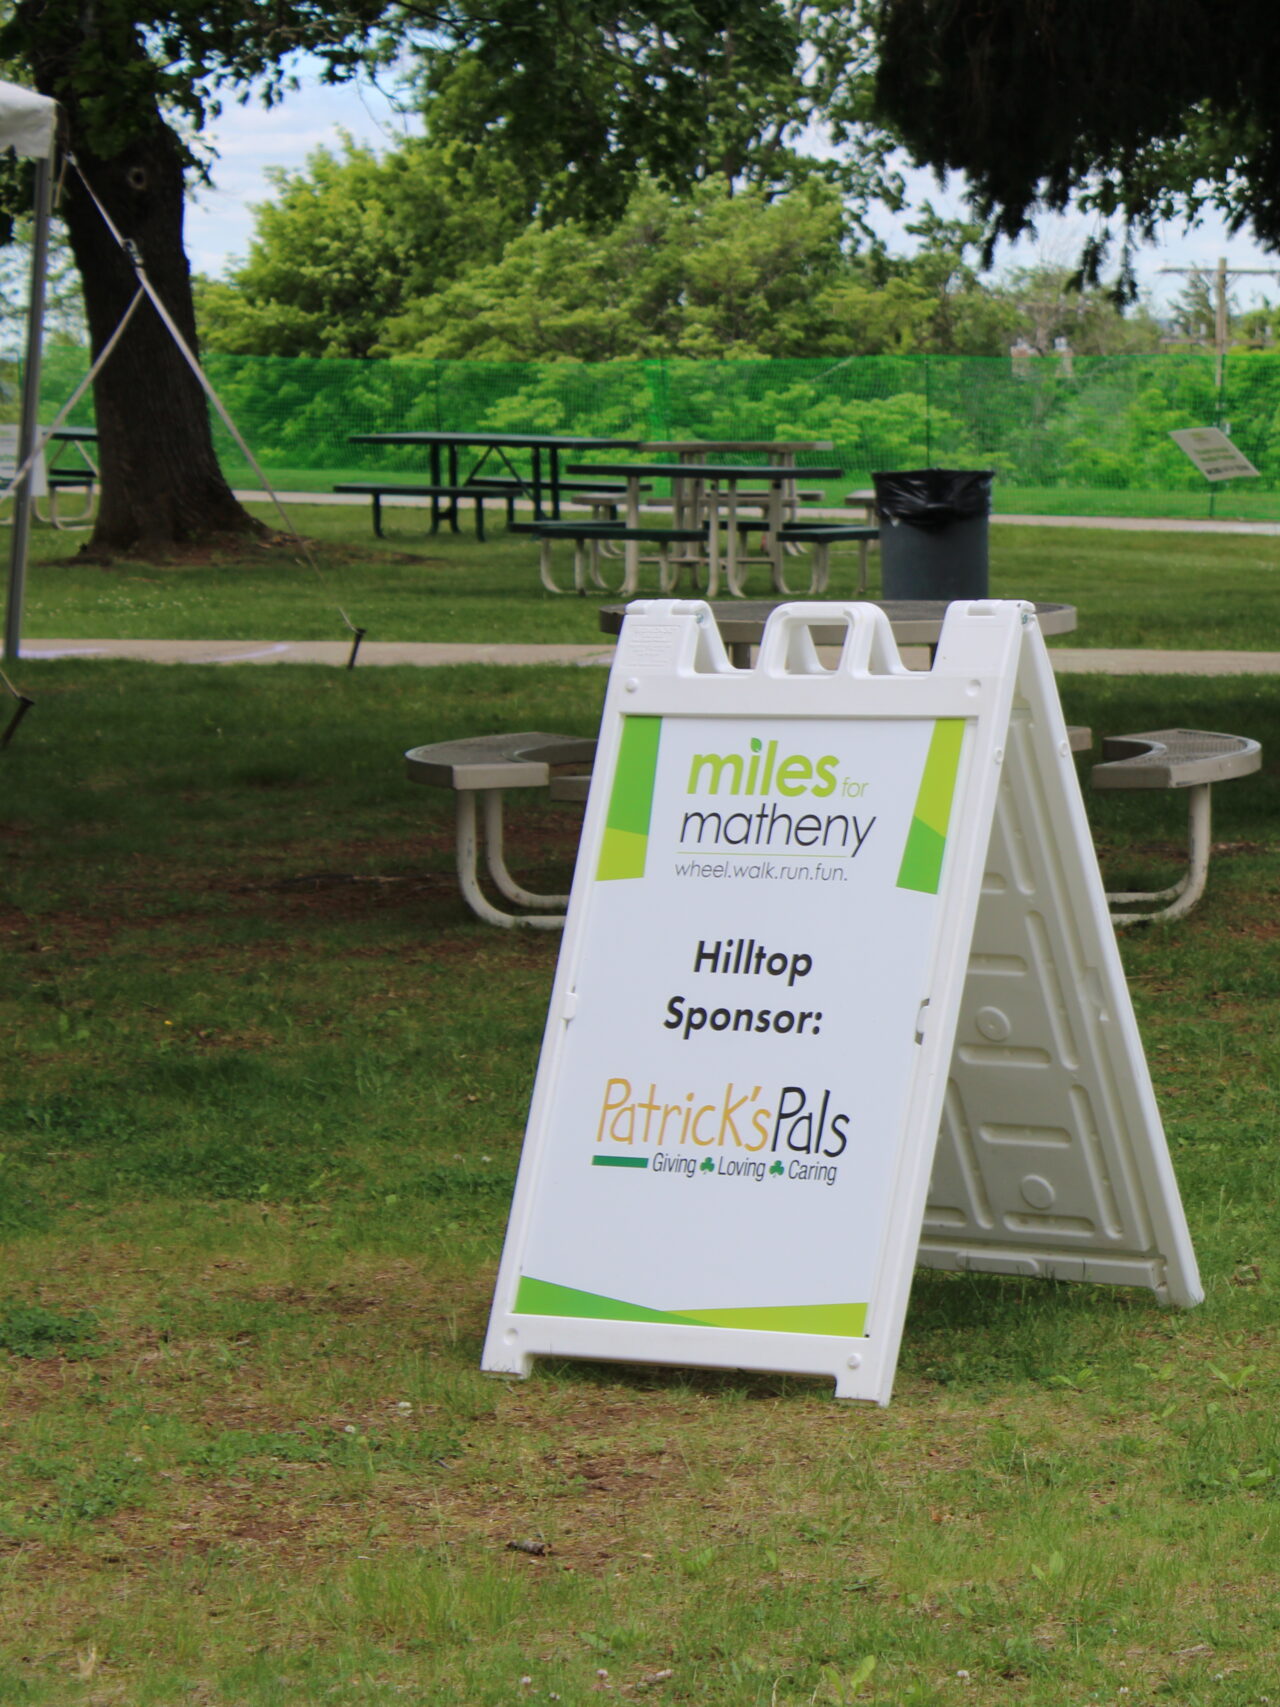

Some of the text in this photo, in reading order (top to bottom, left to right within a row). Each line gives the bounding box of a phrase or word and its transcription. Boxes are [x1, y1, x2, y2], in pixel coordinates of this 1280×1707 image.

[686, 737, 869, 798] miles for
[679, 802, 877, 858] matheny
[675, 860, 848, 882] wheel.walk.run.fun.
[693, 938, 812, 987] Hilltop
[663, 995, 822, 1040] Sponsor:
[652, 1152, 838, 1186] Giving Loving Caring
